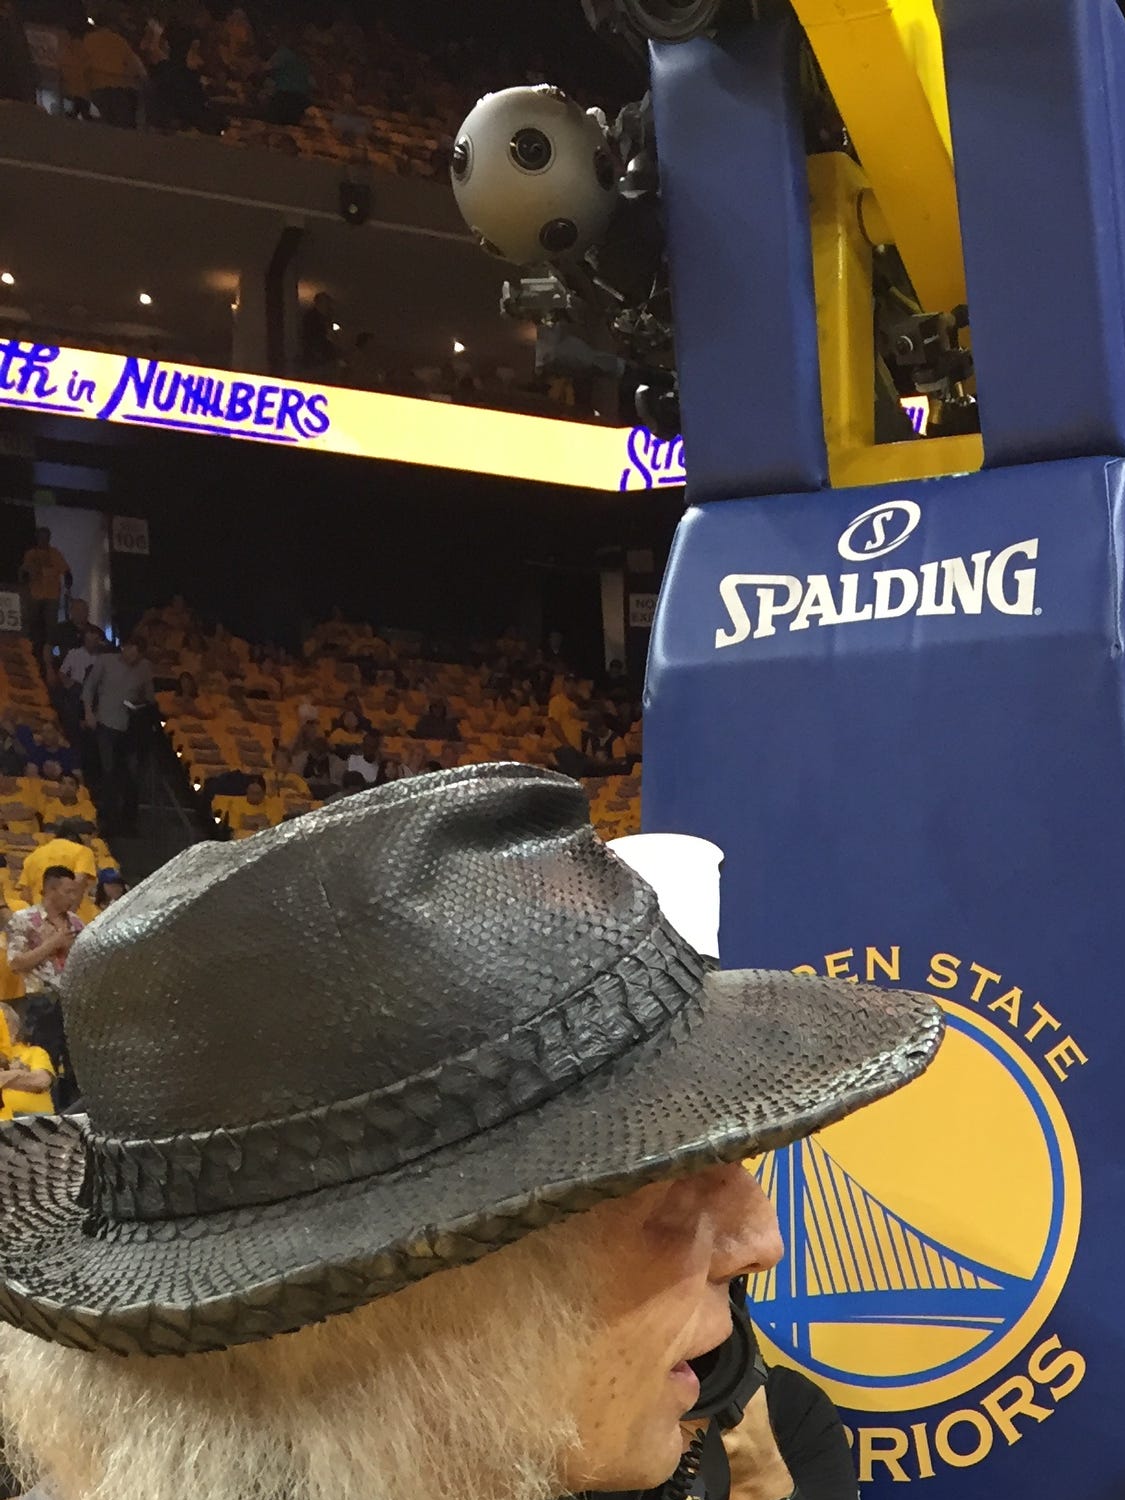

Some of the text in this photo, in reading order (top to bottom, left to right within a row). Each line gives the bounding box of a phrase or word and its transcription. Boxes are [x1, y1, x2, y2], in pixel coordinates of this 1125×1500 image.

[66, 370, 96, 403] in
[715, 538, 1039, 648] SPALDING
[926, 953, 1088, 1082] STATE
[843, 1333, 1087, 1482] RIORS
